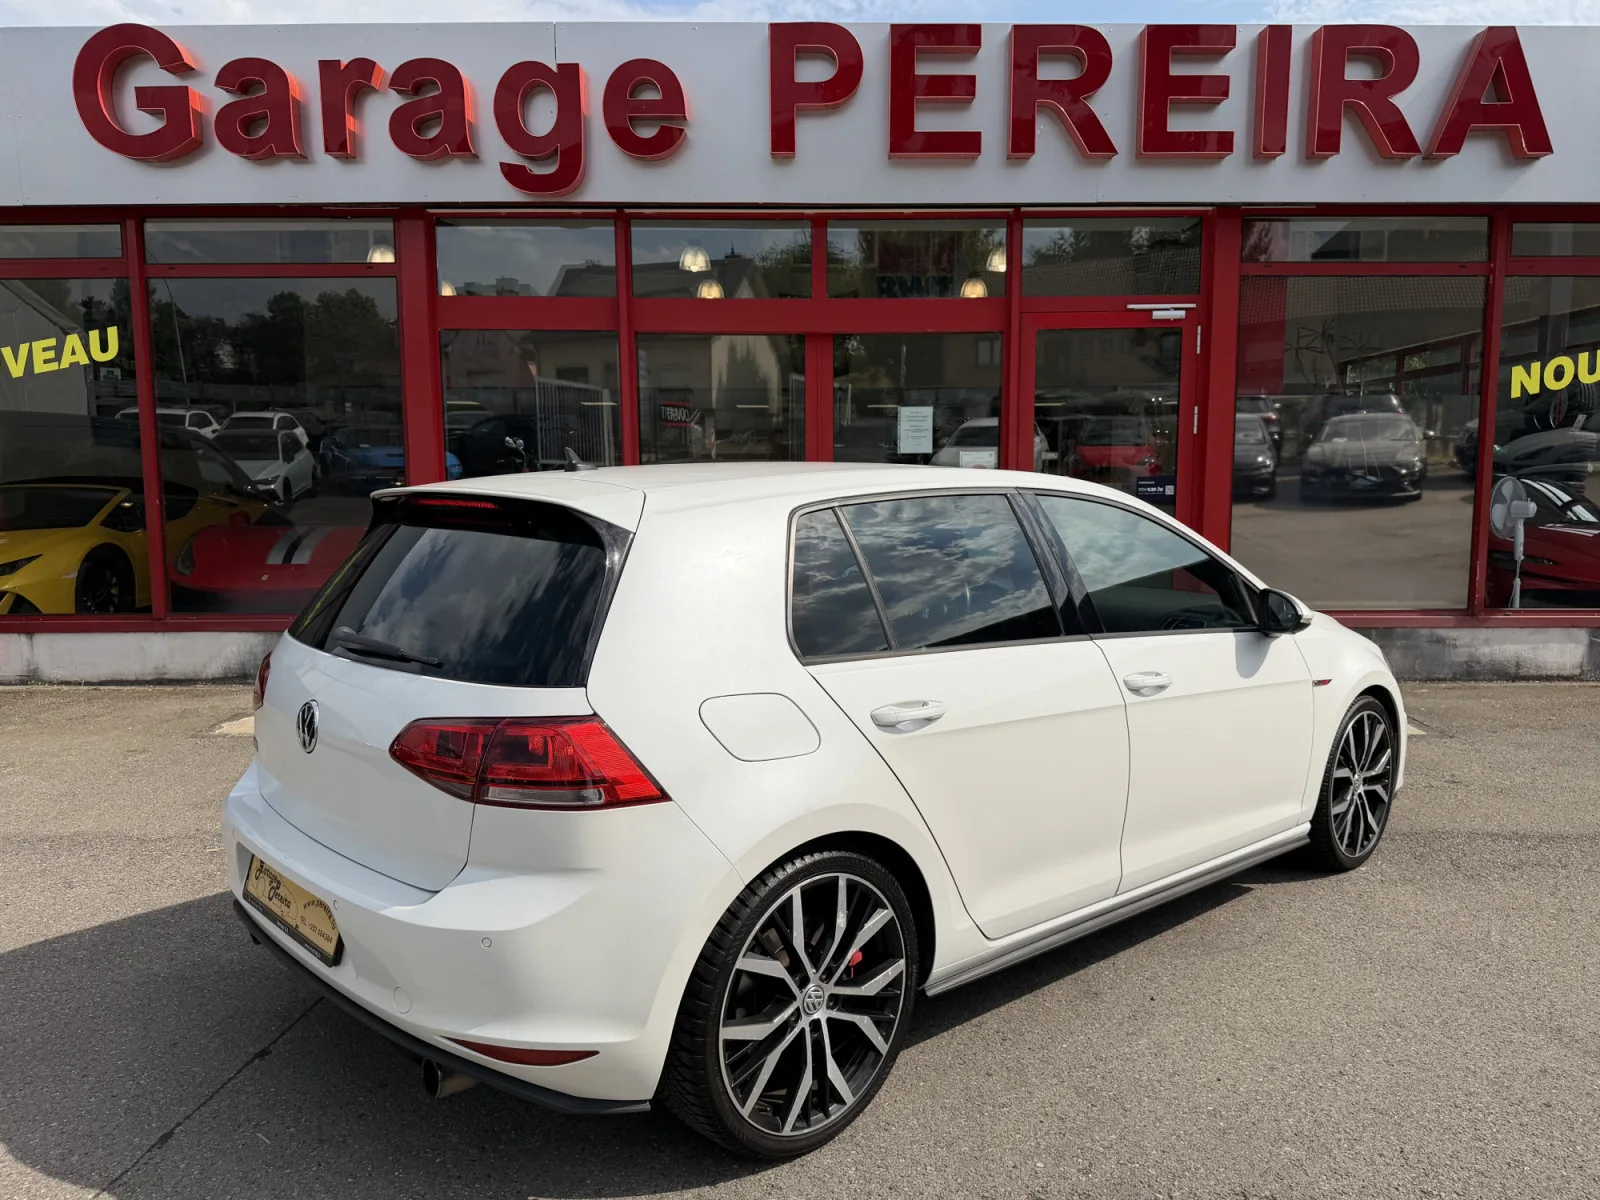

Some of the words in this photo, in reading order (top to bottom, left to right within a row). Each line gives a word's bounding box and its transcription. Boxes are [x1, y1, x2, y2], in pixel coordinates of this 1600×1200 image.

[73, 23, 687, 196] Garage
[769, 23, 1553, 161] PEREIRA
[0, 325, 120, 379] VEAU
[1510, 348, 1600, 399] NOU
